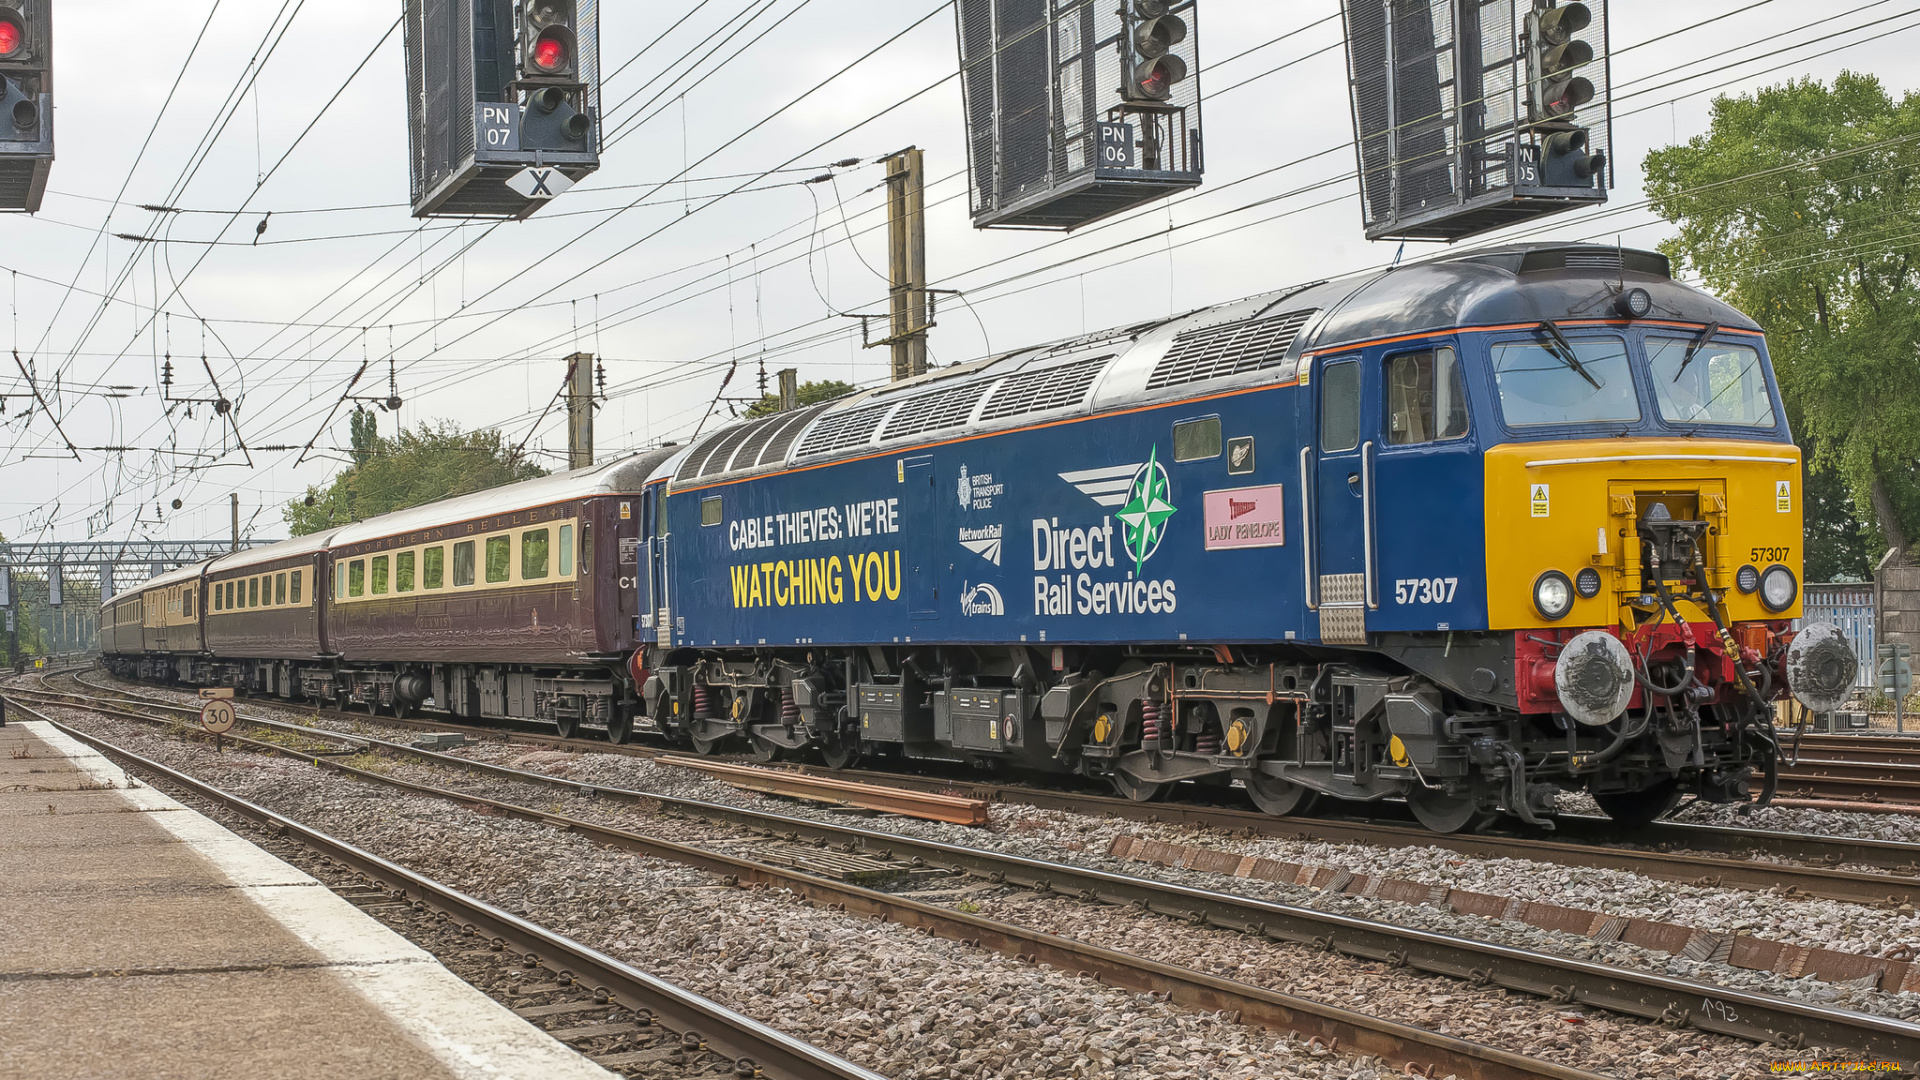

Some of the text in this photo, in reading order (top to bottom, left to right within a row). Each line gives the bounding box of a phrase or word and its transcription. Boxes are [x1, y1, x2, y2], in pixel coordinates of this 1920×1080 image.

[483, 107, 510, 124] PN
[487, 128, 511, 145] 07
[1102, 126, 1125, 142] PN
[1106, 146, 1126, 162] 06
[529, 170, 553, 196] X
[972, 473, 993, 487] BRITISH
[973, 483, 1004, 498] TRANSPORT
[973, 498, 993, 510] POLICE
[355, 511, 538, 554] NORTHERN BELLE
[729, 498, 899, 551] CABLE THIEVES: WE'RE
[1209, 520, 1280, 541] LADY PENELOPE
[1032, 515, 1115, 571] Direct
[1750, 547, 1790, 562] 57307
[619, 576, 637, 589] C1
[730, 550, 901, 609] WATCHING YOU
[1034, 570, 1177, 616] Rail Services
[1395, 577, 1458, 605] 57307
[972, 601, 992, 614] trains
[207, 708, 229, 725] 30
